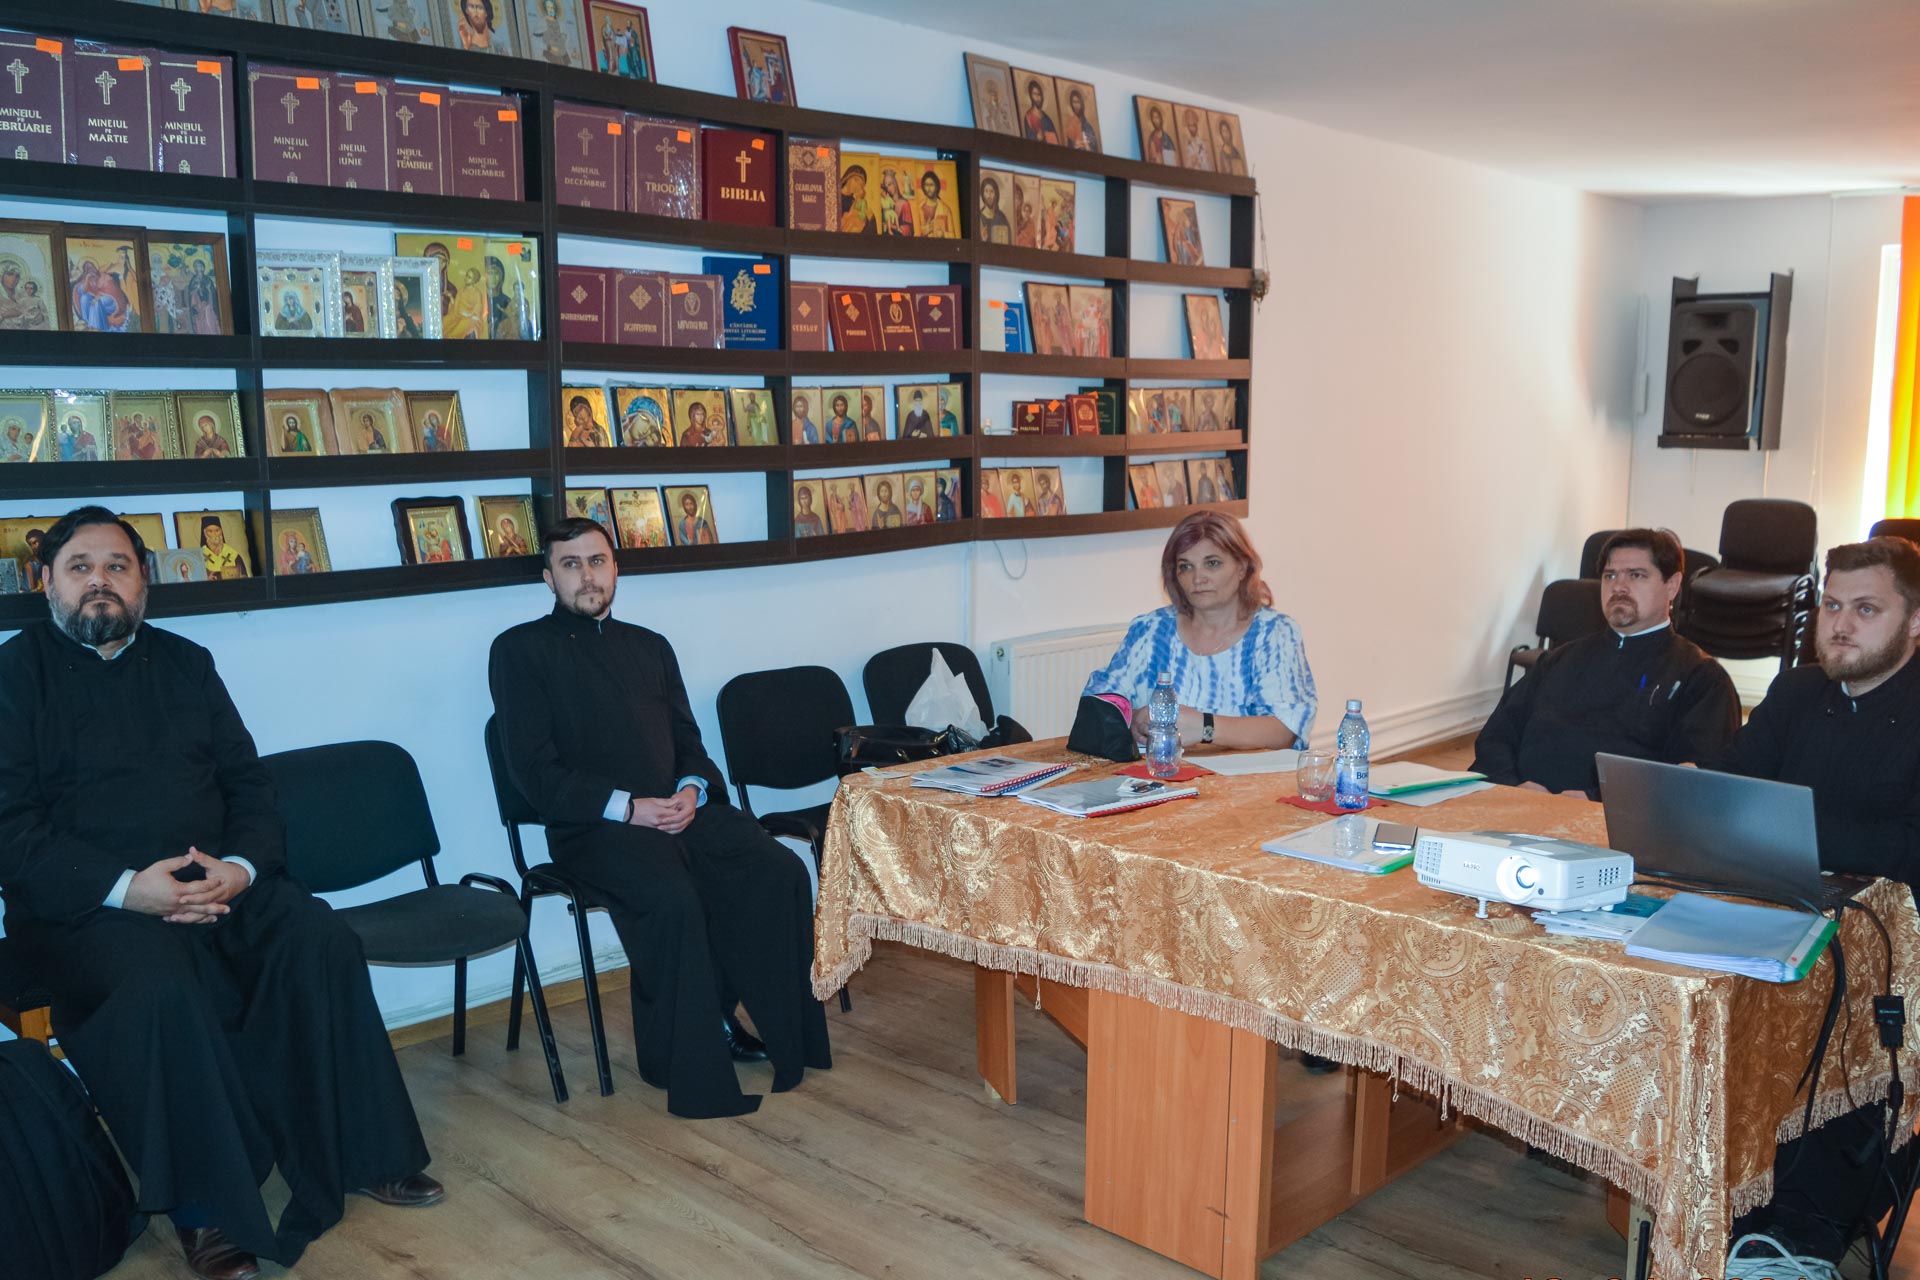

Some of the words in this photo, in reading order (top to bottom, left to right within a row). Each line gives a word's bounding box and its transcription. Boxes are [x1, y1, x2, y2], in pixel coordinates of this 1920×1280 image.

[0, 107, 42, 119] MINEIUL
[88, 118, 128, 129] MINEIUL
[165, 121, 203, 132] MINEIUL
[89, 133, 128, 144] MARTIE
[162, 133, 206, 145] APRILIE
[273, 136, 309, 147] MINEIUL
[338, 143, 368, 153] INEIUL
[397, 147, 423, 157] INEIUL
[282, 151, 301, 160] MAI
[338, 156, 362, 166] IUNIE
[721, 186, 765, 202] BIBLIA
